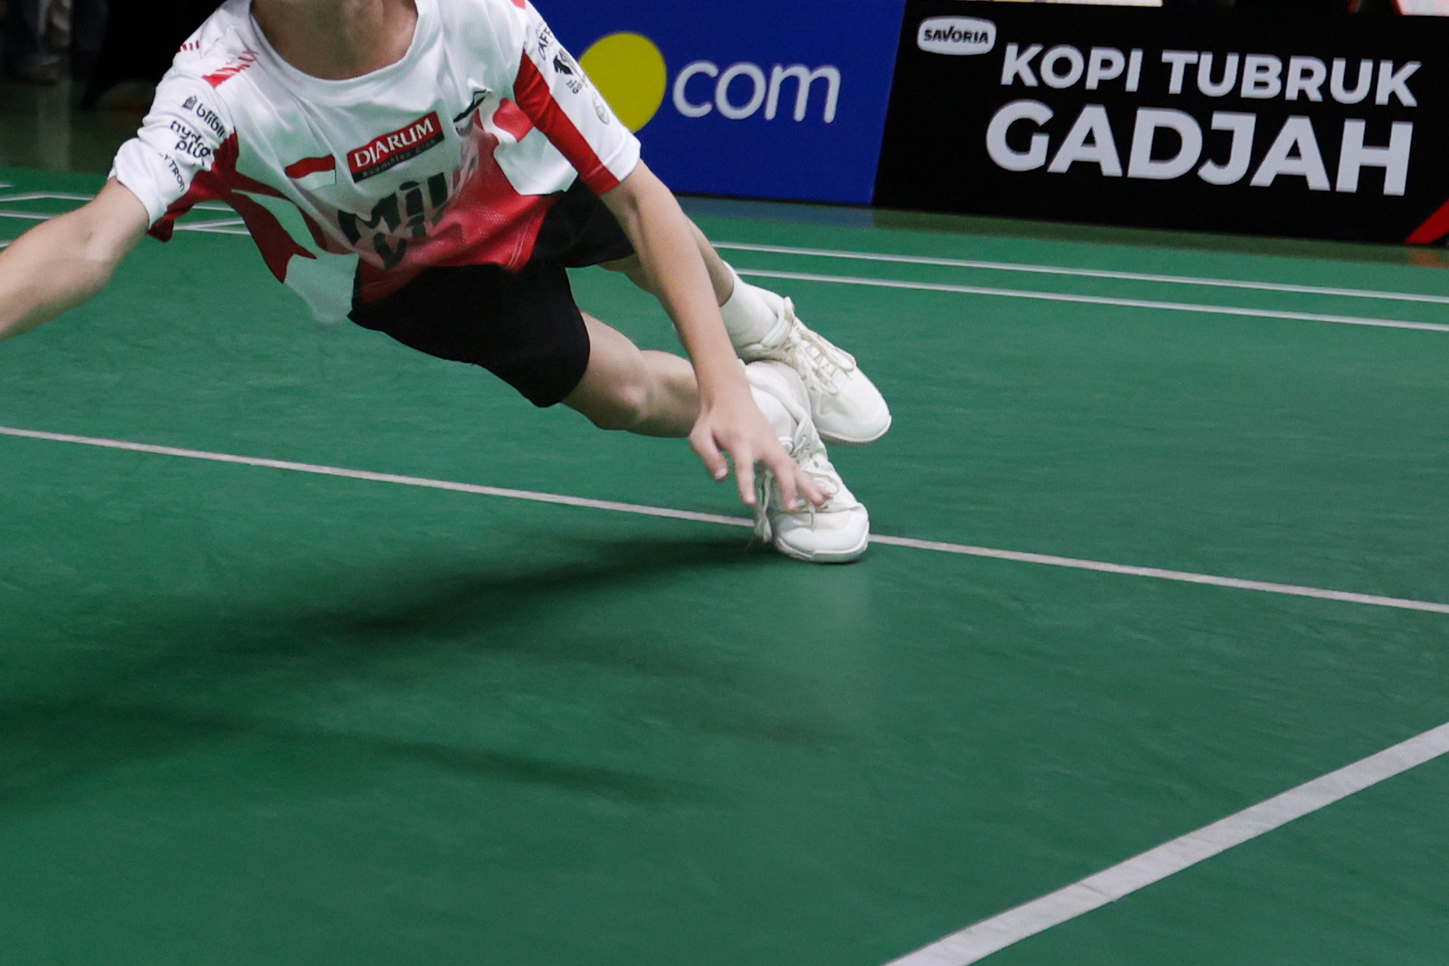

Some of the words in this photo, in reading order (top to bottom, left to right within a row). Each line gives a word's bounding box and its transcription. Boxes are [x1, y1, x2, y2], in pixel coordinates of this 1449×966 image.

[924, 26, 989, 44] SAVORIA
[1001, 43, 1142, 92] KOPI
[1160, 49, 1422, 107] TUBRUK
[354, 117, 434, 167] DJARUM
[986, 100, 1413, 196] GADJAH
